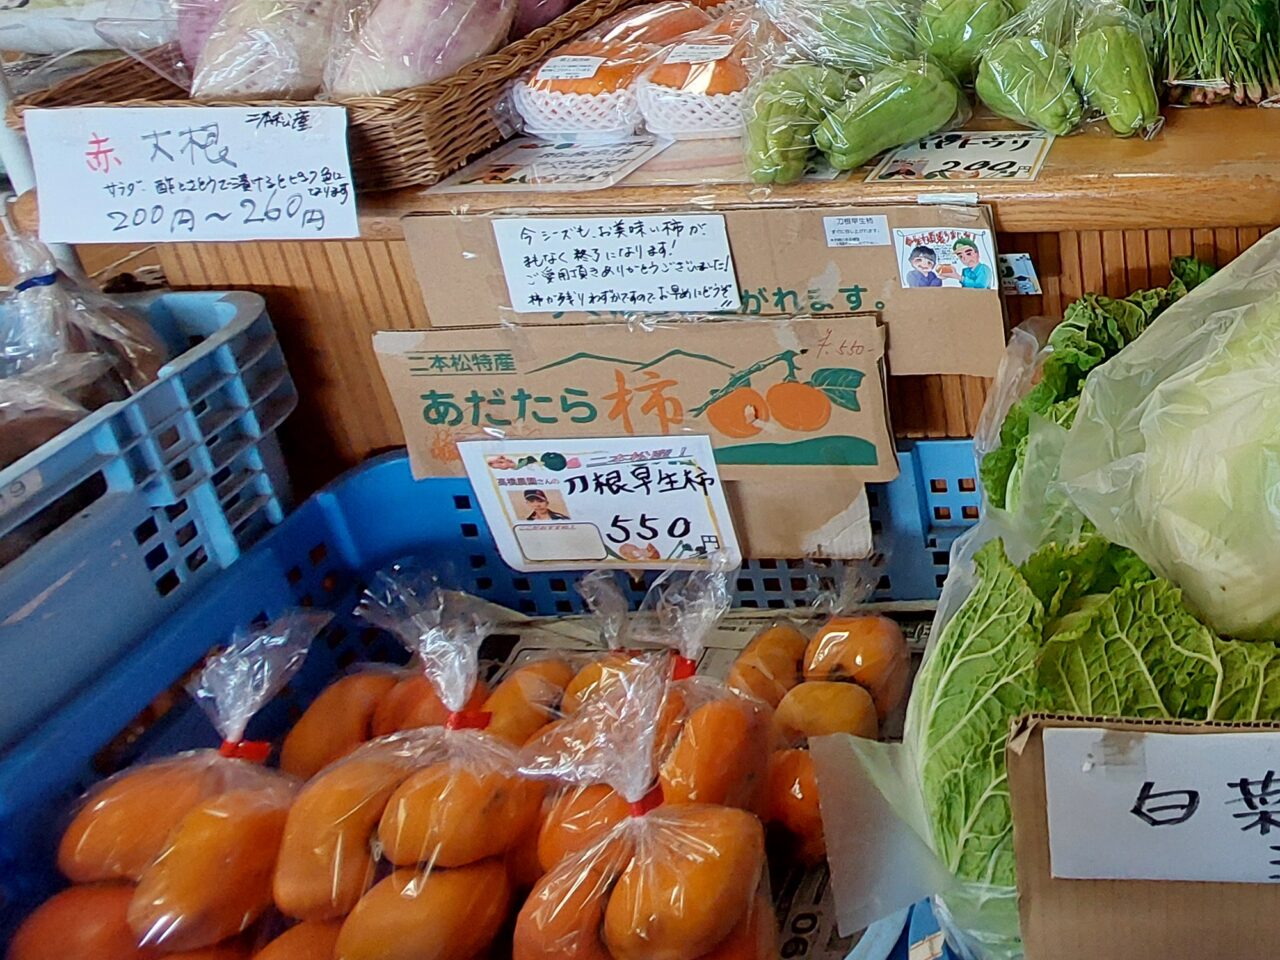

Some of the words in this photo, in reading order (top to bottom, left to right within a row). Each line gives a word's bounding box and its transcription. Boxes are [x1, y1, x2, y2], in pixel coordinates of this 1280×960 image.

[941, 159, 1018, 172] 200
[407, 352, 518, 375] 二本松特産
[565, 465, 716, 497] 刀根早生柿
[606, 513, 692, 544] 550
[700, 534, 721, 553] 円
